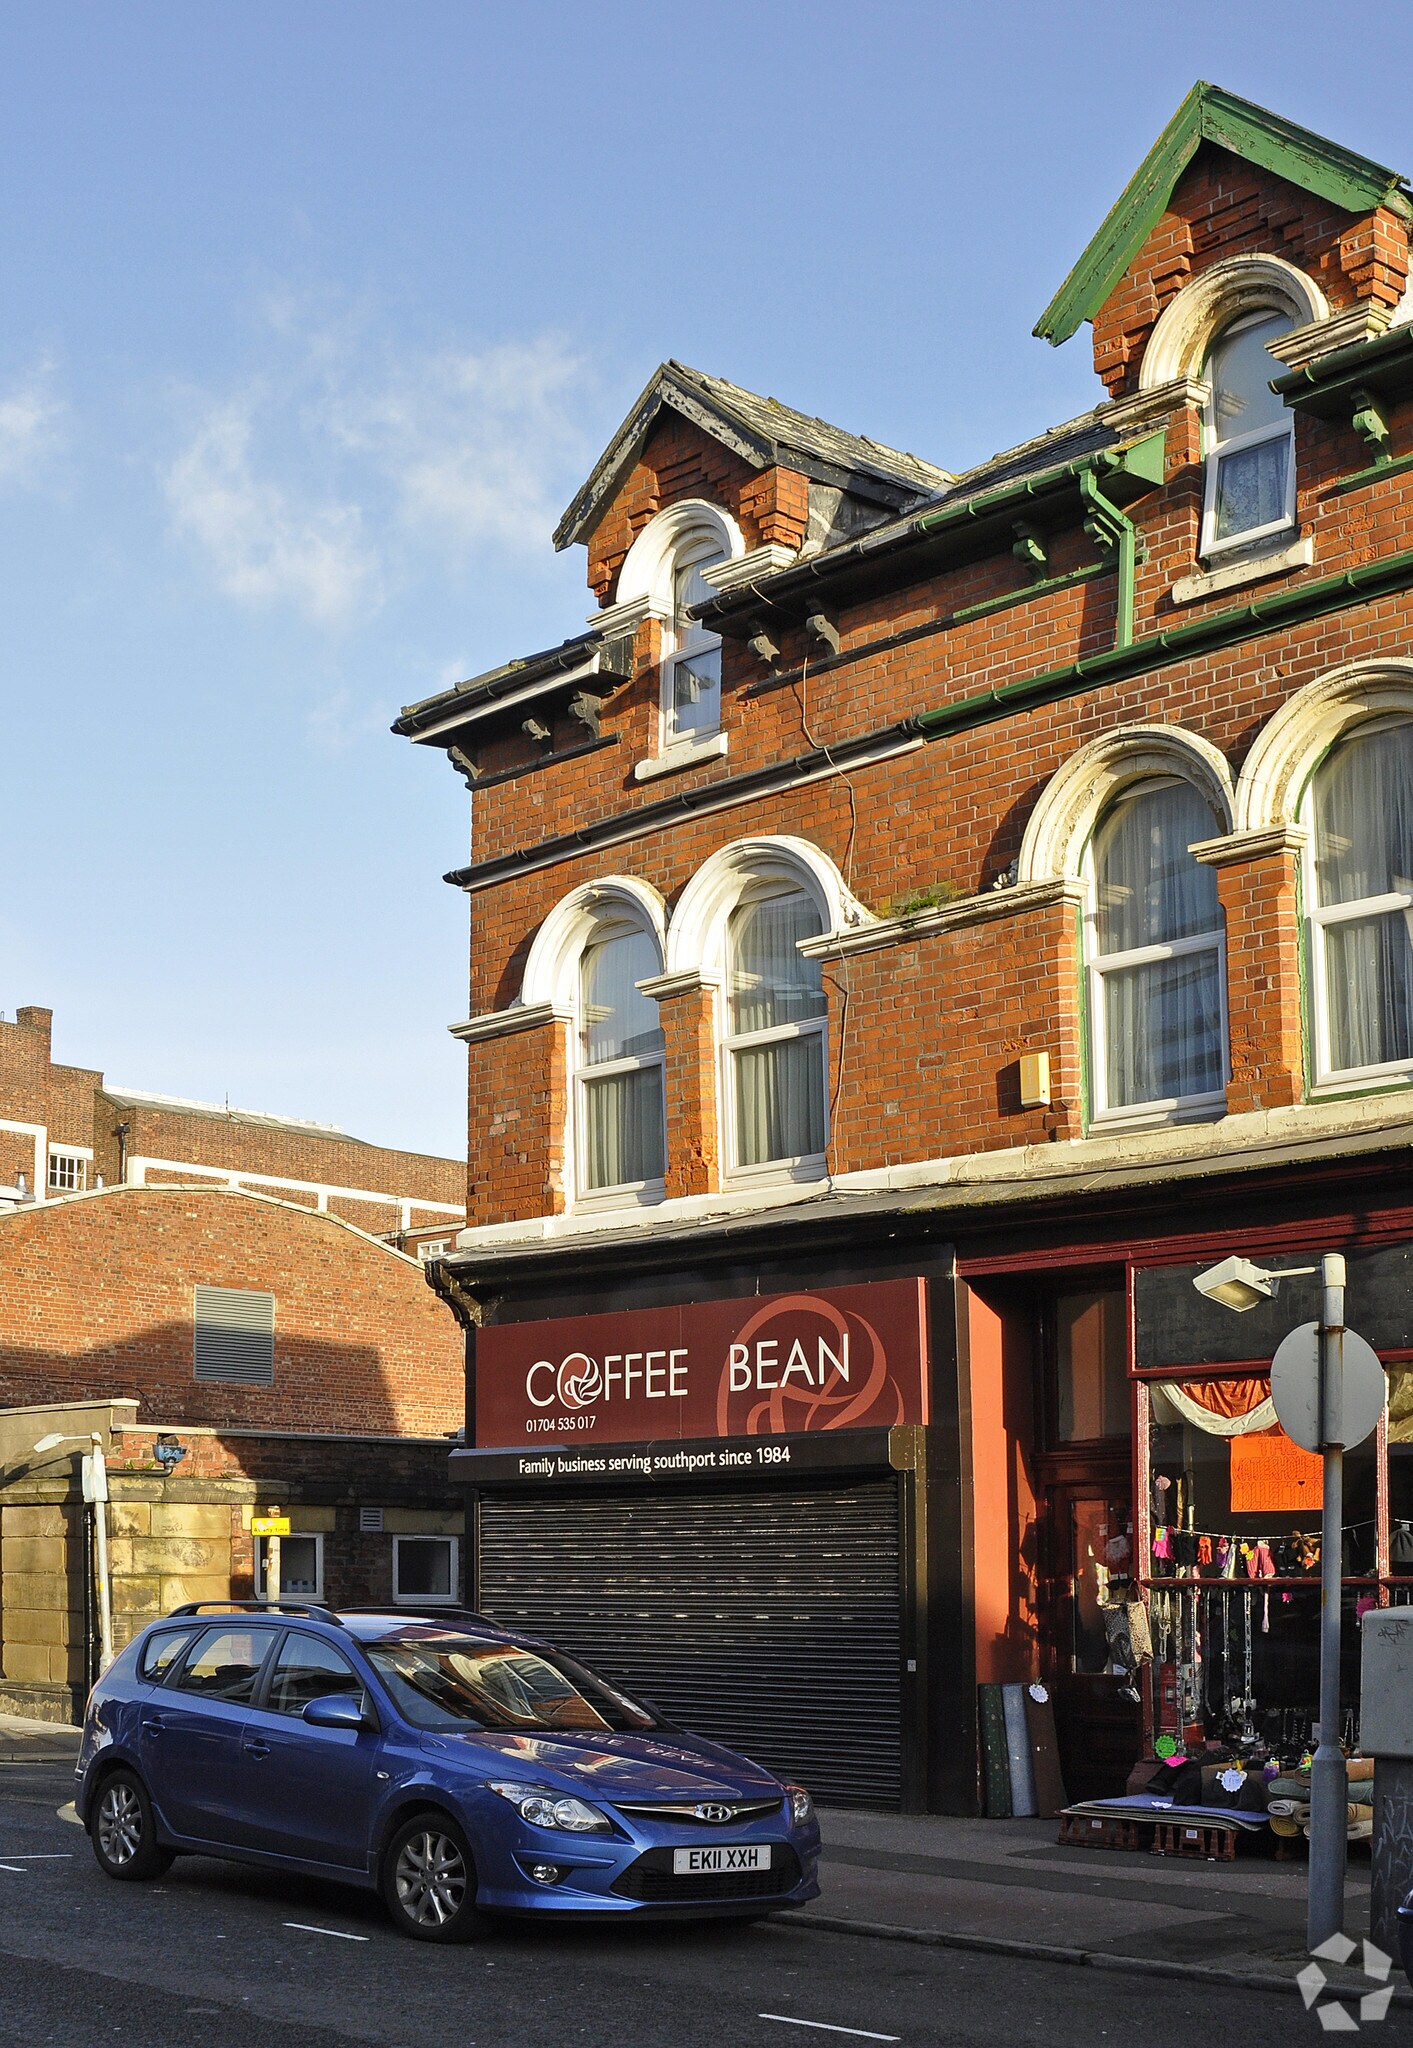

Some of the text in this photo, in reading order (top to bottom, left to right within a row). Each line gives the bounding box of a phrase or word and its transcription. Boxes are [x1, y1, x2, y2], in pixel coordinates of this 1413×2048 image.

[526, 1333, 849, 1410] COFFEE BEAN
[526, 1415, 596, 1433] 01704 535 017
[1258, 1438, 1298, 1456] THE
[519, 1446, 791, 1477] Family business serving southport since 1984
[689, 1848, 758, 1870] EK11 XXH
